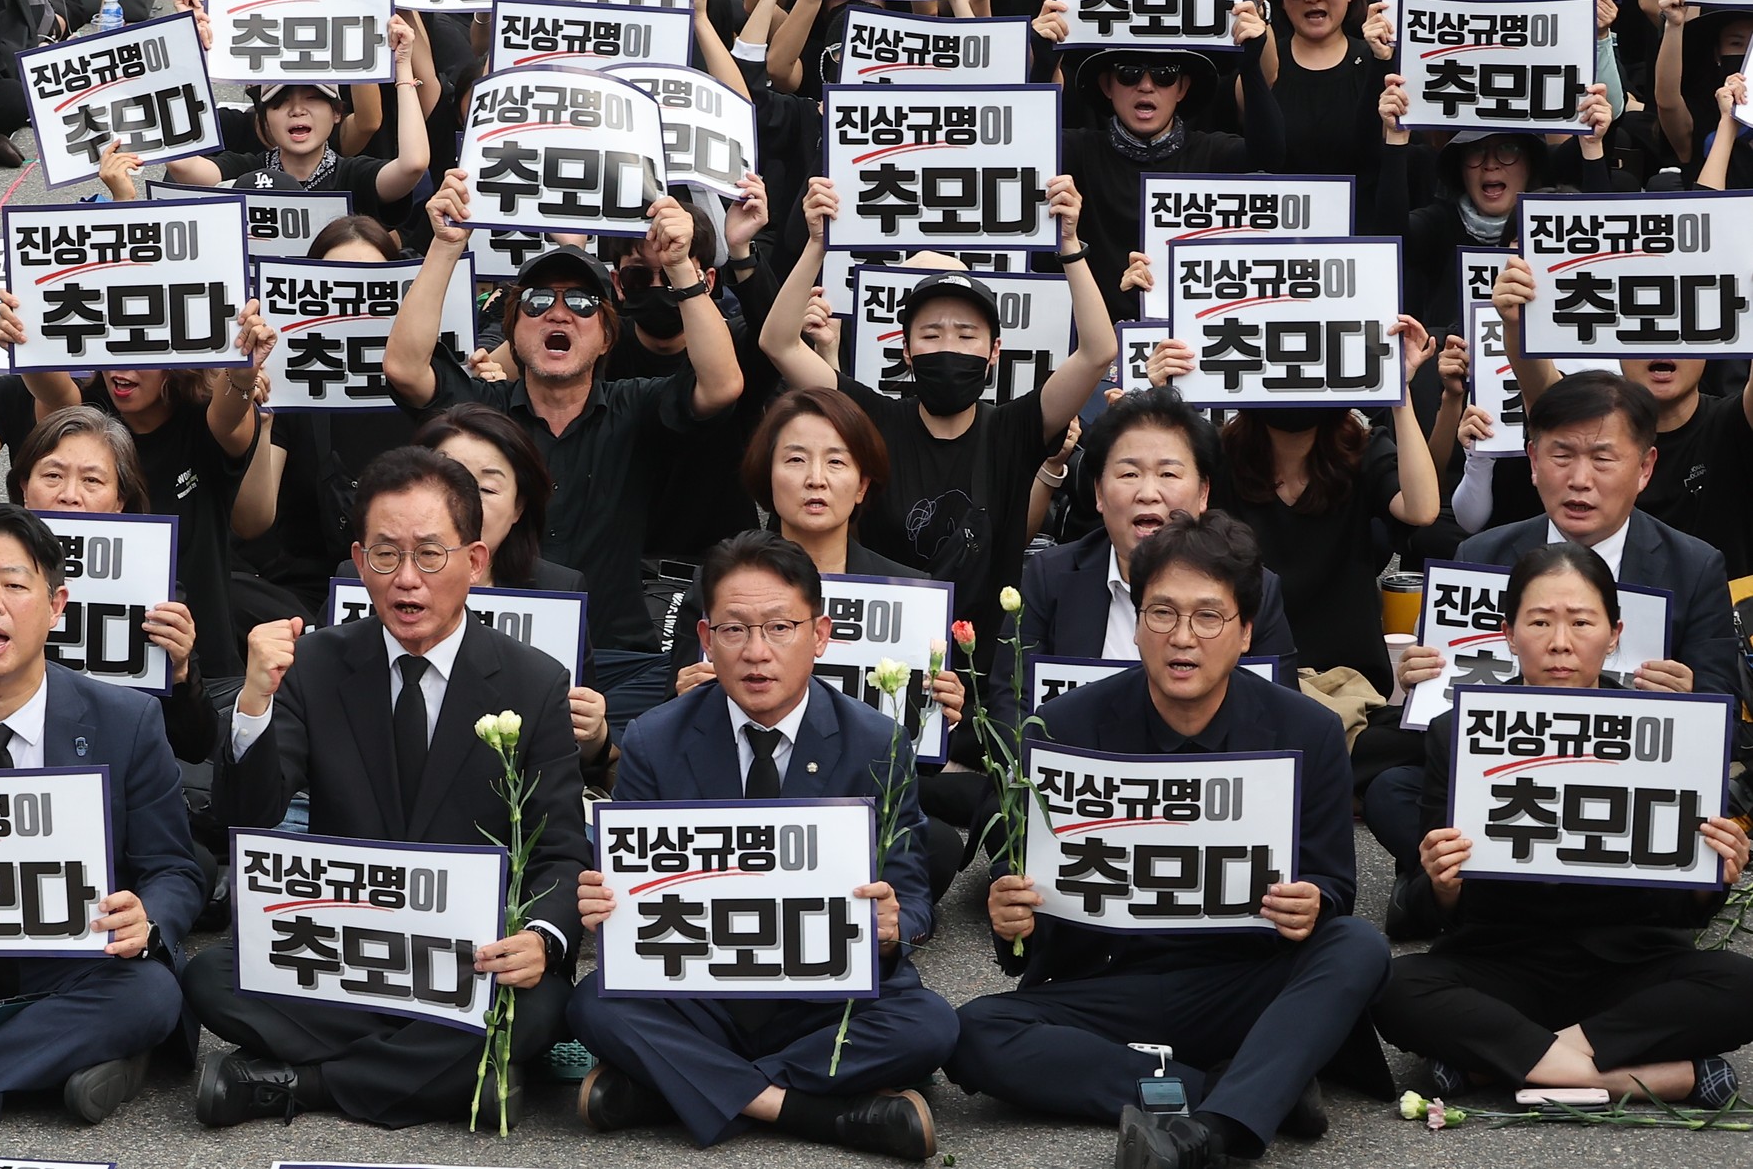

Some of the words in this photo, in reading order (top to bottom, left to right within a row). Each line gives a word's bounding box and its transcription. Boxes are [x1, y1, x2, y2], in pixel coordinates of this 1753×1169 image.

[230, 14, 383, 73] 추모다
[501, 14, 652, 58] 진상규명이
[850, 23, 990, 68] 진상규명이
[1407, 8, 1558, 48] 진상규명이
[30, 37, 170, 98] 진상규명이
[1423, 58, 1587, 120] 추모다
[64, 84, 205, 164] 추모다
[471, 83, 633, 132] 진상규명이
[835, 104, 1012, 146] 진상규명이
[476, 139, 662, 222] 추모다
[855, 163, 1048, 236] 추모다
[1151, 192, 1311, 230] 진상규명이
[1530, 213, 1711, 254] 진상규명이
[15, 220, 198, 266] 진상규명이
[1179, 259, 1356, 300] 진상규명이
[1552, 271, 1747, 343] 추모다
[41, 282, 235, 354] 추모다
[1200, 317, 1390, 389] 추모다
[1467, 709, 1675, 764] 진상규명이
[1037, 774, 1252, 826] 진상규명이
[1485, 778, 1708, 871] 추모다
[608, 824, 818, 873] 진상규명이
[244, 849, 449, 914] 진상규명이
[1056, 842, 1283, 920] 추모다
[267, 918, 489, 1008] 추모다
[636, 893, 861, 981] 추모다
